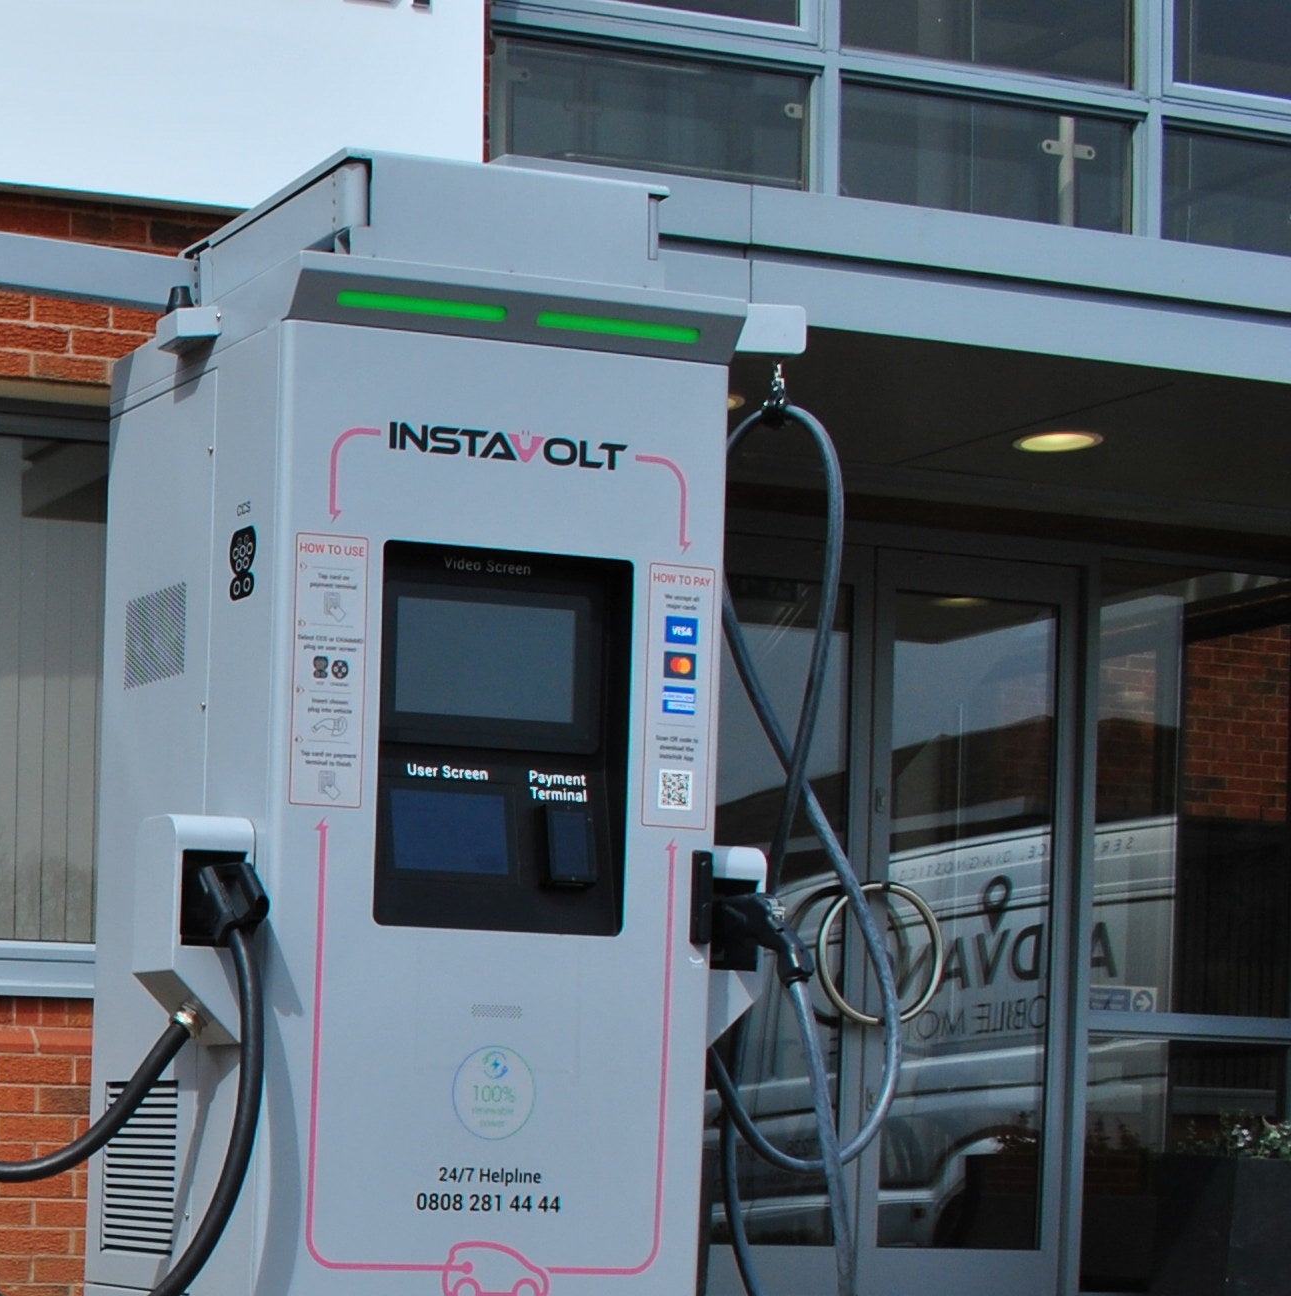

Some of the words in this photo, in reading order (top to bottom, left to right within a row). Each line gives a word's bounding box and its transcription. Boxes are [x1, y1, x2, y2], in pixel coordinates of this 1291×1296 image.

[389, 421, 628, 471] INSTAVOLT
[299, 542, 325, 554] HOW
[327, 544, 342, 555] TO
[344, 546, 365, 557] USE
[444, 557, 482, 571] Video
[486, 560, 531, 575] Screen
[653, 572, 676, 583] HOW
[678, 574, 691, 585] TO
[693, 576, 711, 587] PAY
[671, 625, 693, 637] VISA
[407, 763, 438, 778] User
[442, 765, 489, 781] Screen
[529, 770, 587, 787] Payment
[529, 787, 588, 803] Terminal
[472, 1085, 516, 1103] 100%
[438, 1166, 475, 1183] 24/7
[479, 1167, 542, 1187] Helpline
[416, 1192, 464, 1211] 0808
[469, 1194, 501, 1212] 281
[509, 1195, 533, 1212] 44
[537, 1195, 561, 1213] 44
